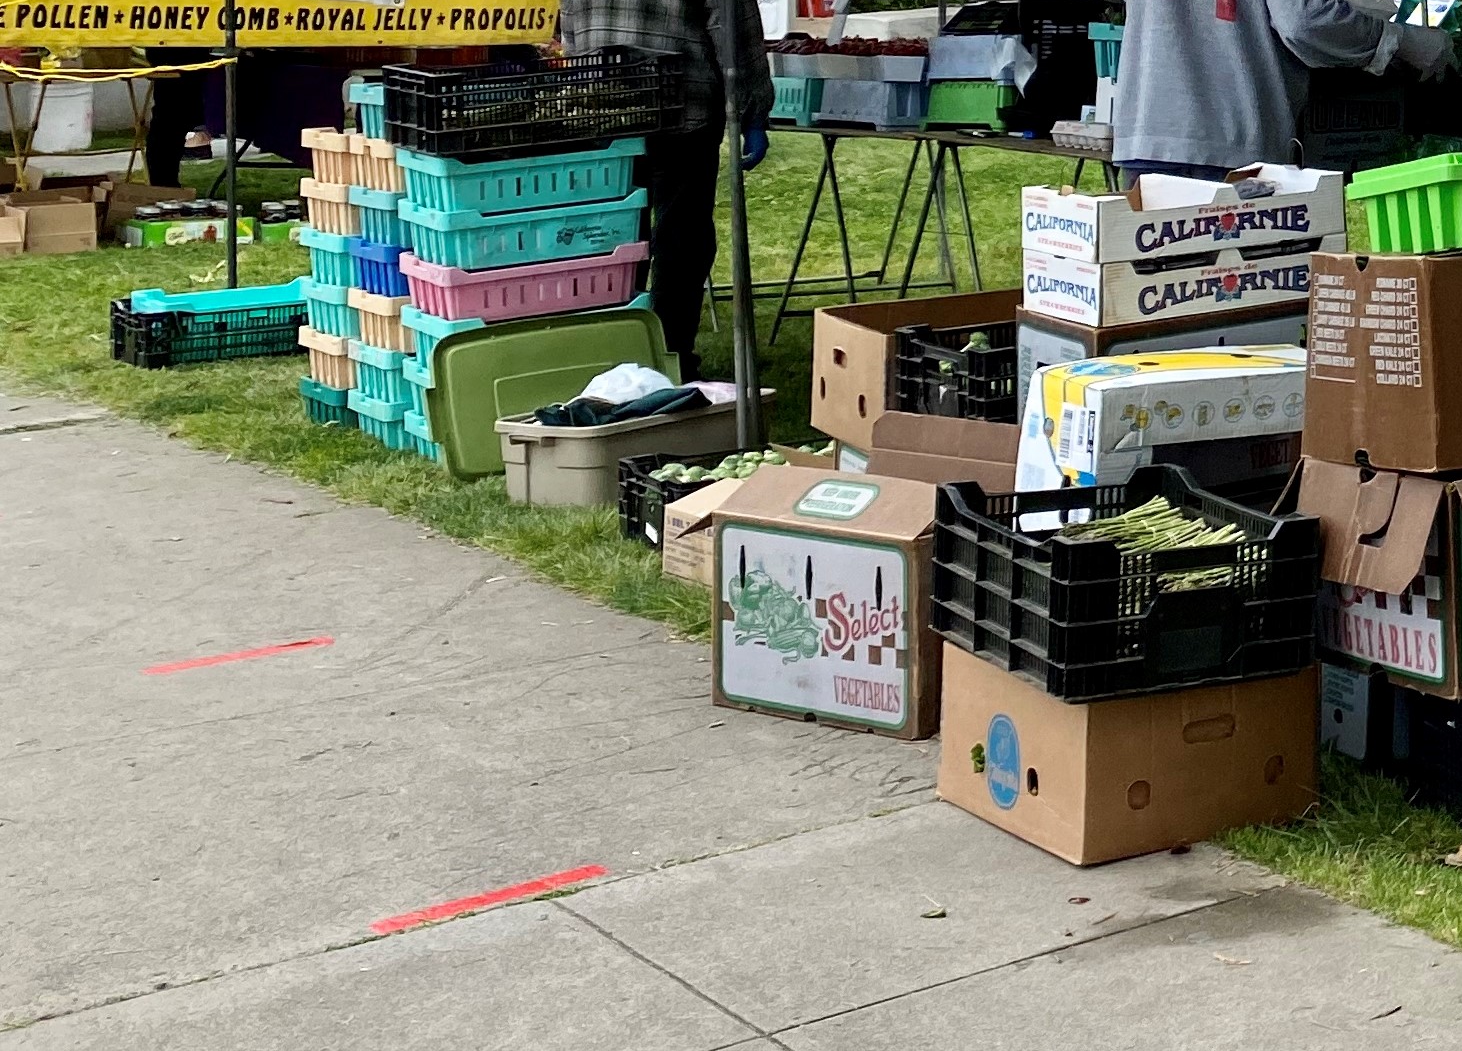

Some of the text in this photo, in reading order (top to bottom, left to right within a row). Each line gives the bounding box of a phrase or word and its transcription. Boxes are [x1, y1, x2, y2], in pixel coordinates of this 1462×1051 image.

[15, 4, 109, 30] POLLEN
[130, 5, 210, 31] HONEY
[296, 8, 366, 31] ROYAL
[373, 8, 433, 31] JELLY
[450, 8, 546, 31] PROPOLIS
[1026, 212, 1095, 245] CALIFORNIA
[1027, 274, 1098, 311] CALIFORNIA
[825, 591, 899, 651] Select
[834, 675, 901, 714] VEGETABLES
